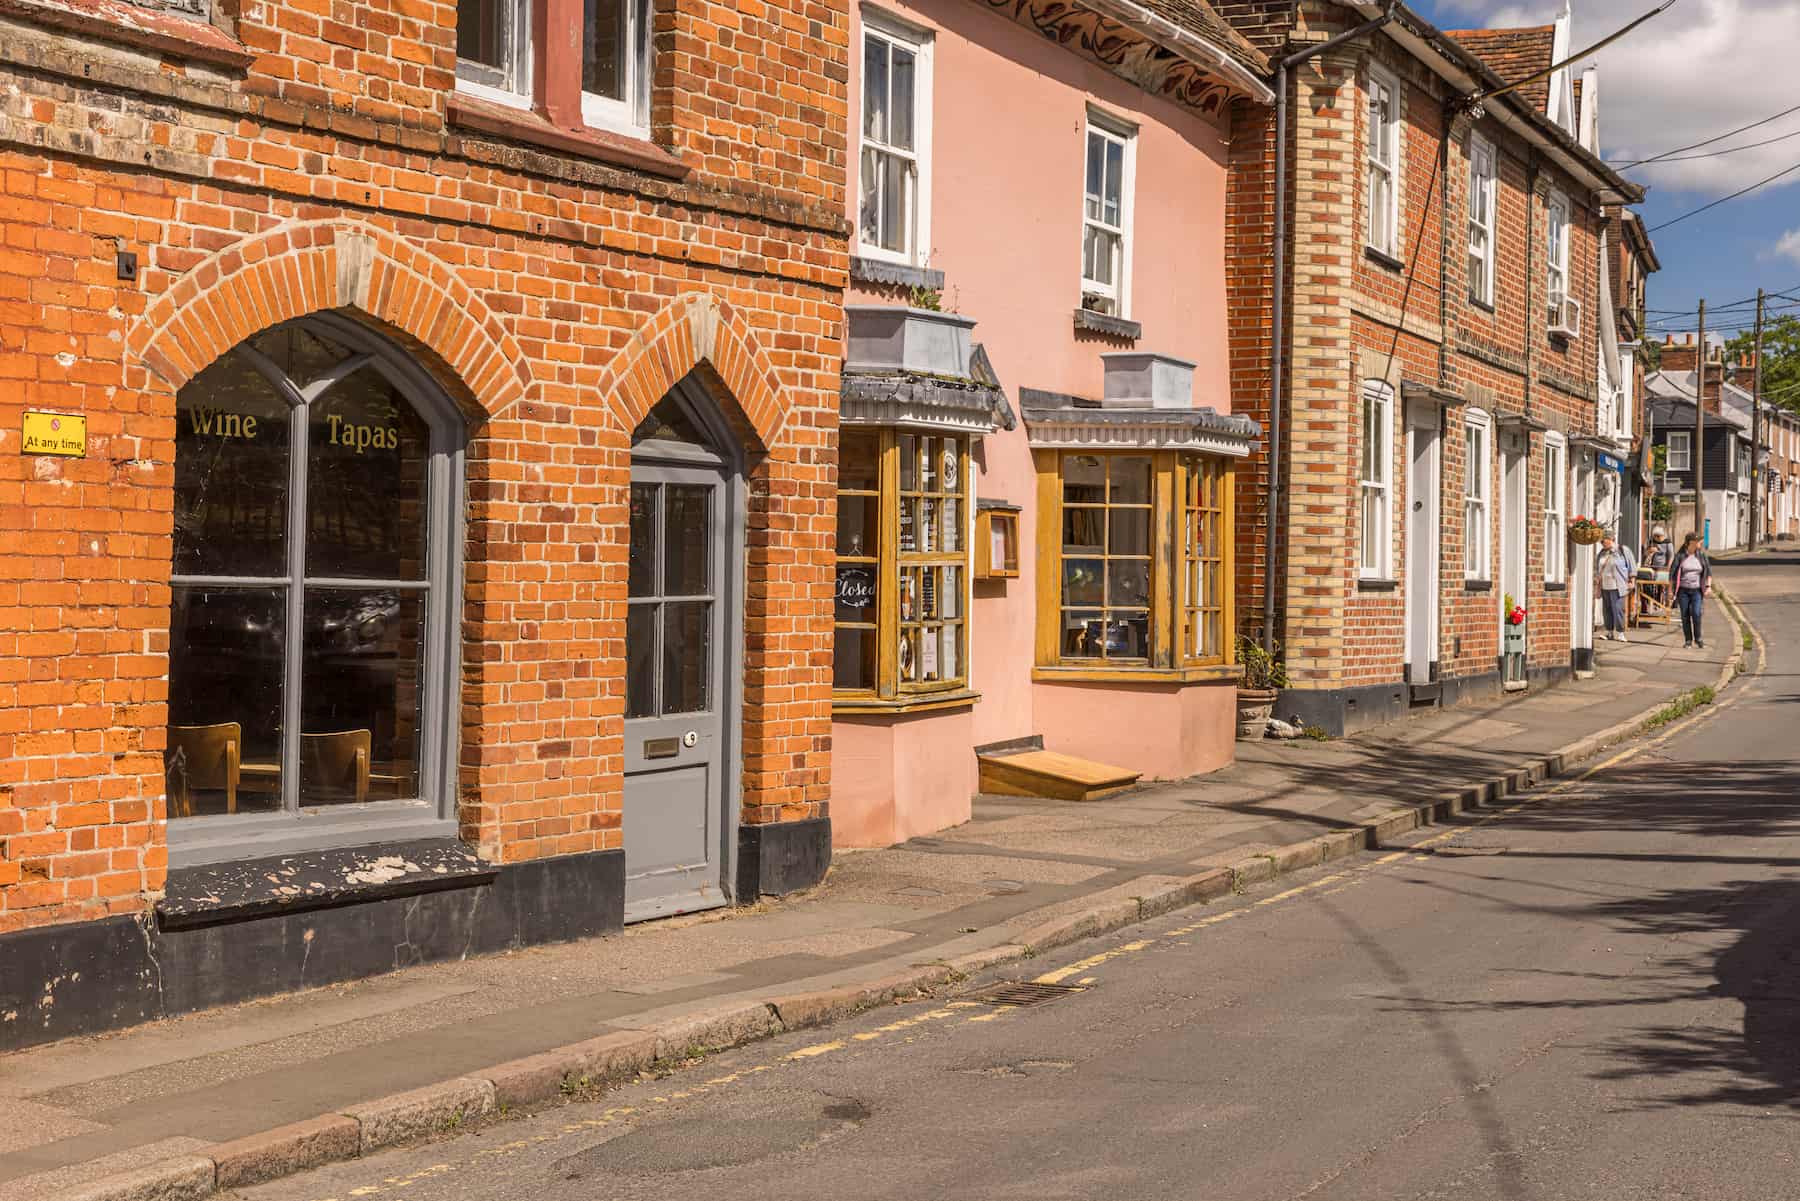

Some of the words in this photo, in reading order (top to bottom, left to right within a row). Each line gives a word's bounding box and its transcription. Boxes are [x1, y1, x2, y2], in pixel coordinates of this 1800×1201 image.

[26, 436, 38, 447] At
[41, 439, 58, 450] any
[62, 438, 82, 450] time
[191, 405, 257, 439] Wine
[327, 414, 398, 454] Tapas
